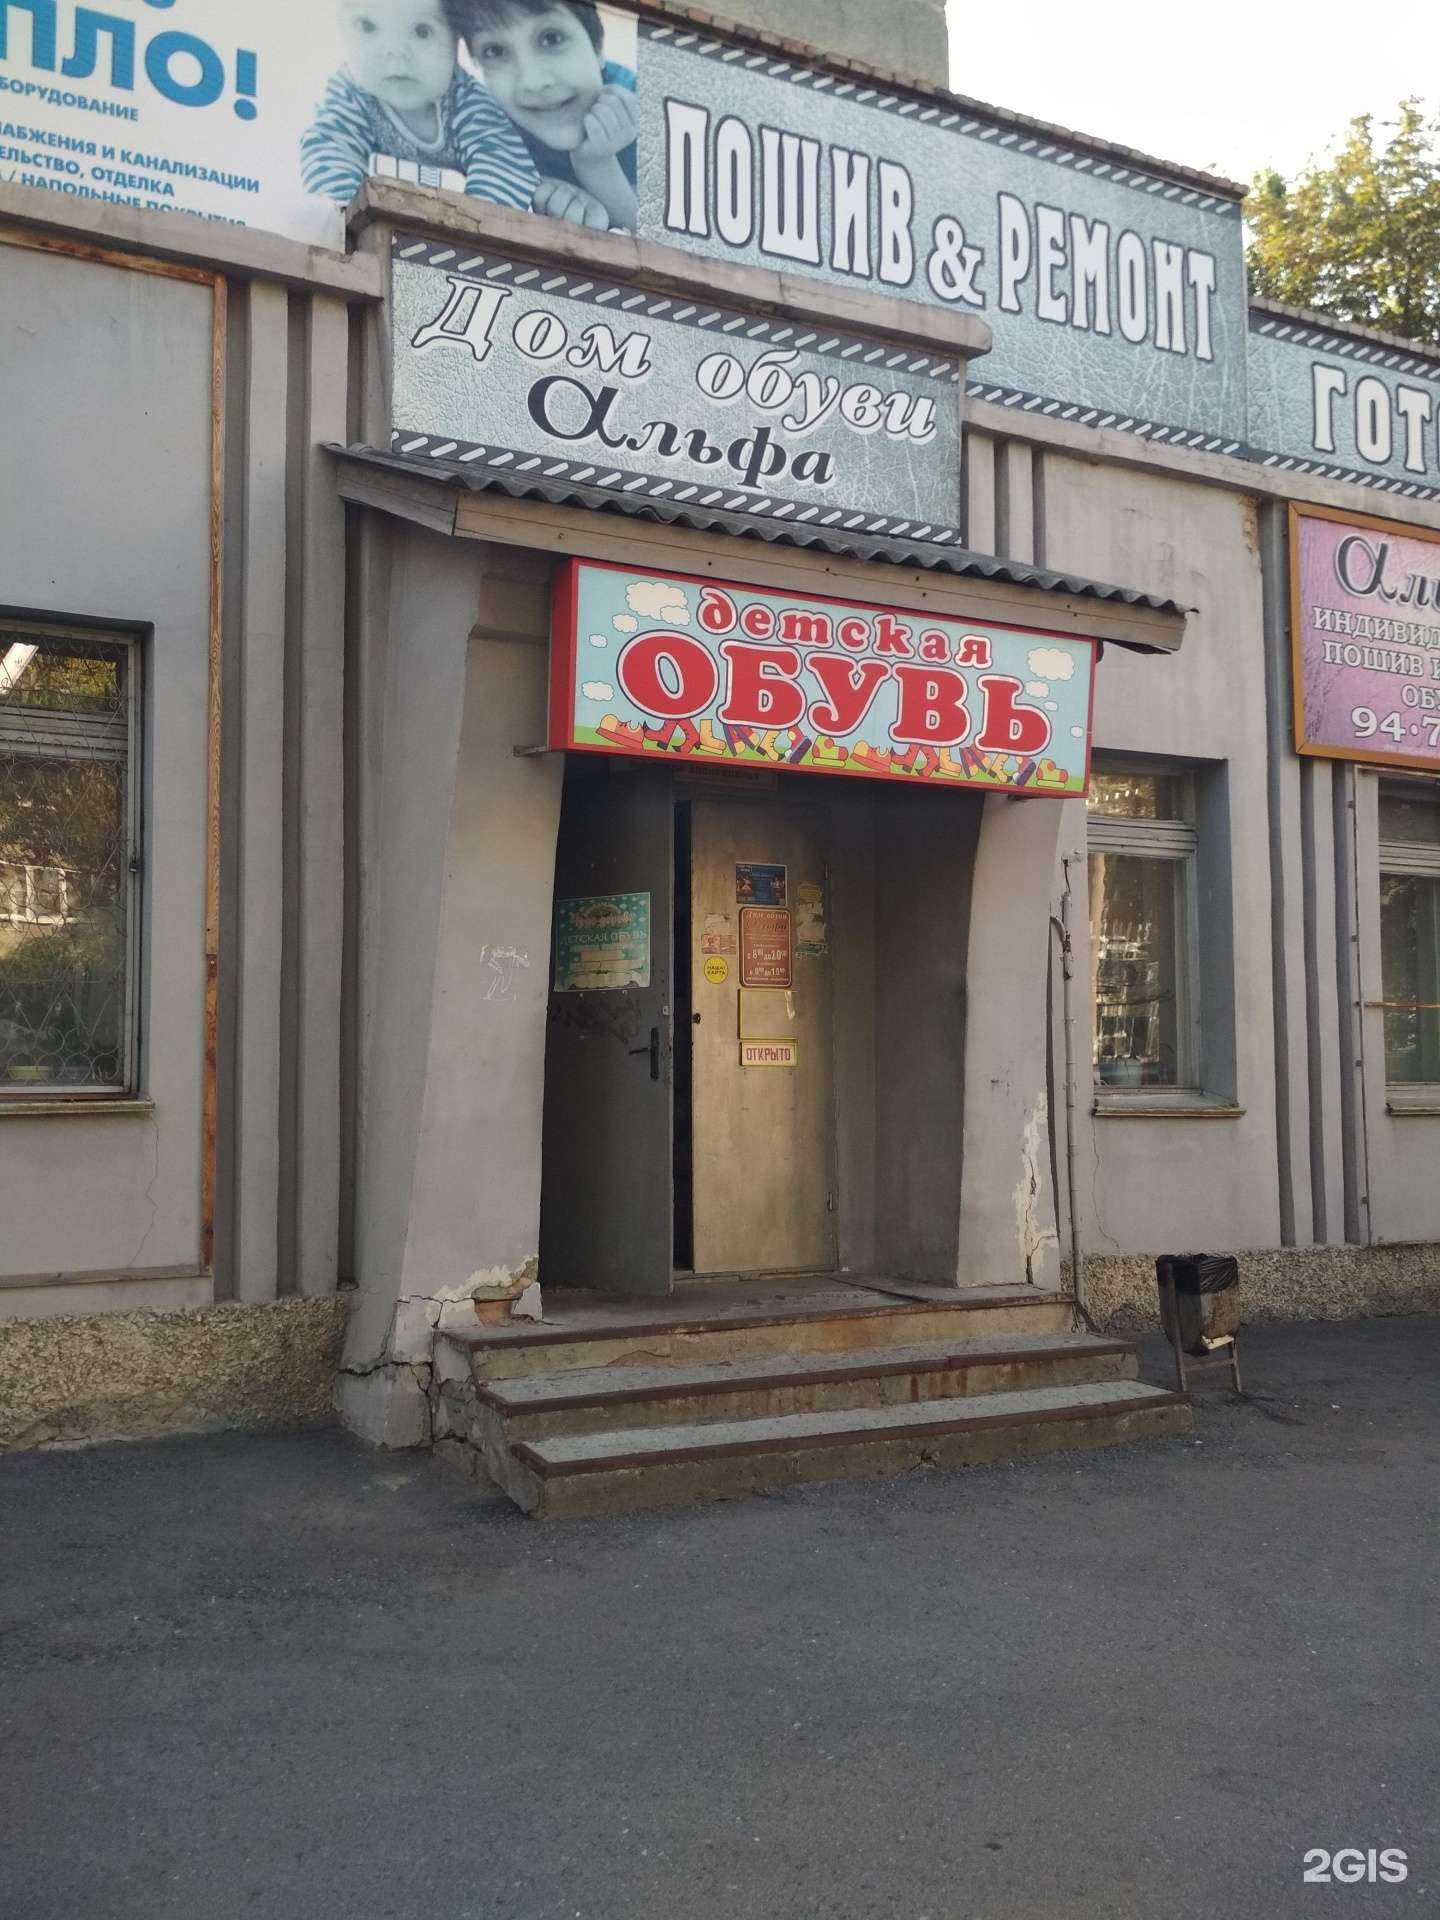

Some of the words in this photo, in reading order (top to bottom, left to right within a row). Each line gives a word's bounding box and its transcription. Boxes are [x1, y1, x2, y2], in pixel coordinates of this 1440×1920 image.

[0, 121, 97, 157] АБЖЕНИЯ
[102, 144, 115, 160] И
[120, 149, 261, 194] КАНАЛИЗАЦИИ
[91, 166, 175, 197] ОТДЕЛКА
[663, 98, 914, 286] ПОШИВ
[926, 214, 986, 308] &
[998, 191, 1216, 362] РЕМОНТ
[410, 276, 652, 379] Дом
[696, 349, 938, 439] обуви
[527, 375, 835, 489] Альфа
[1311, 361, 1440, 475] ГОТ
[697, 586, 994, 669] детская
[1323, 640, 1424, 678] ПОШИВ
[616, 629, 1052, 756] ОБУВЬ
[1401, 683, 1440, 711] ОБ
[746, 1047, 791, 1061] ОТКРЫТО
